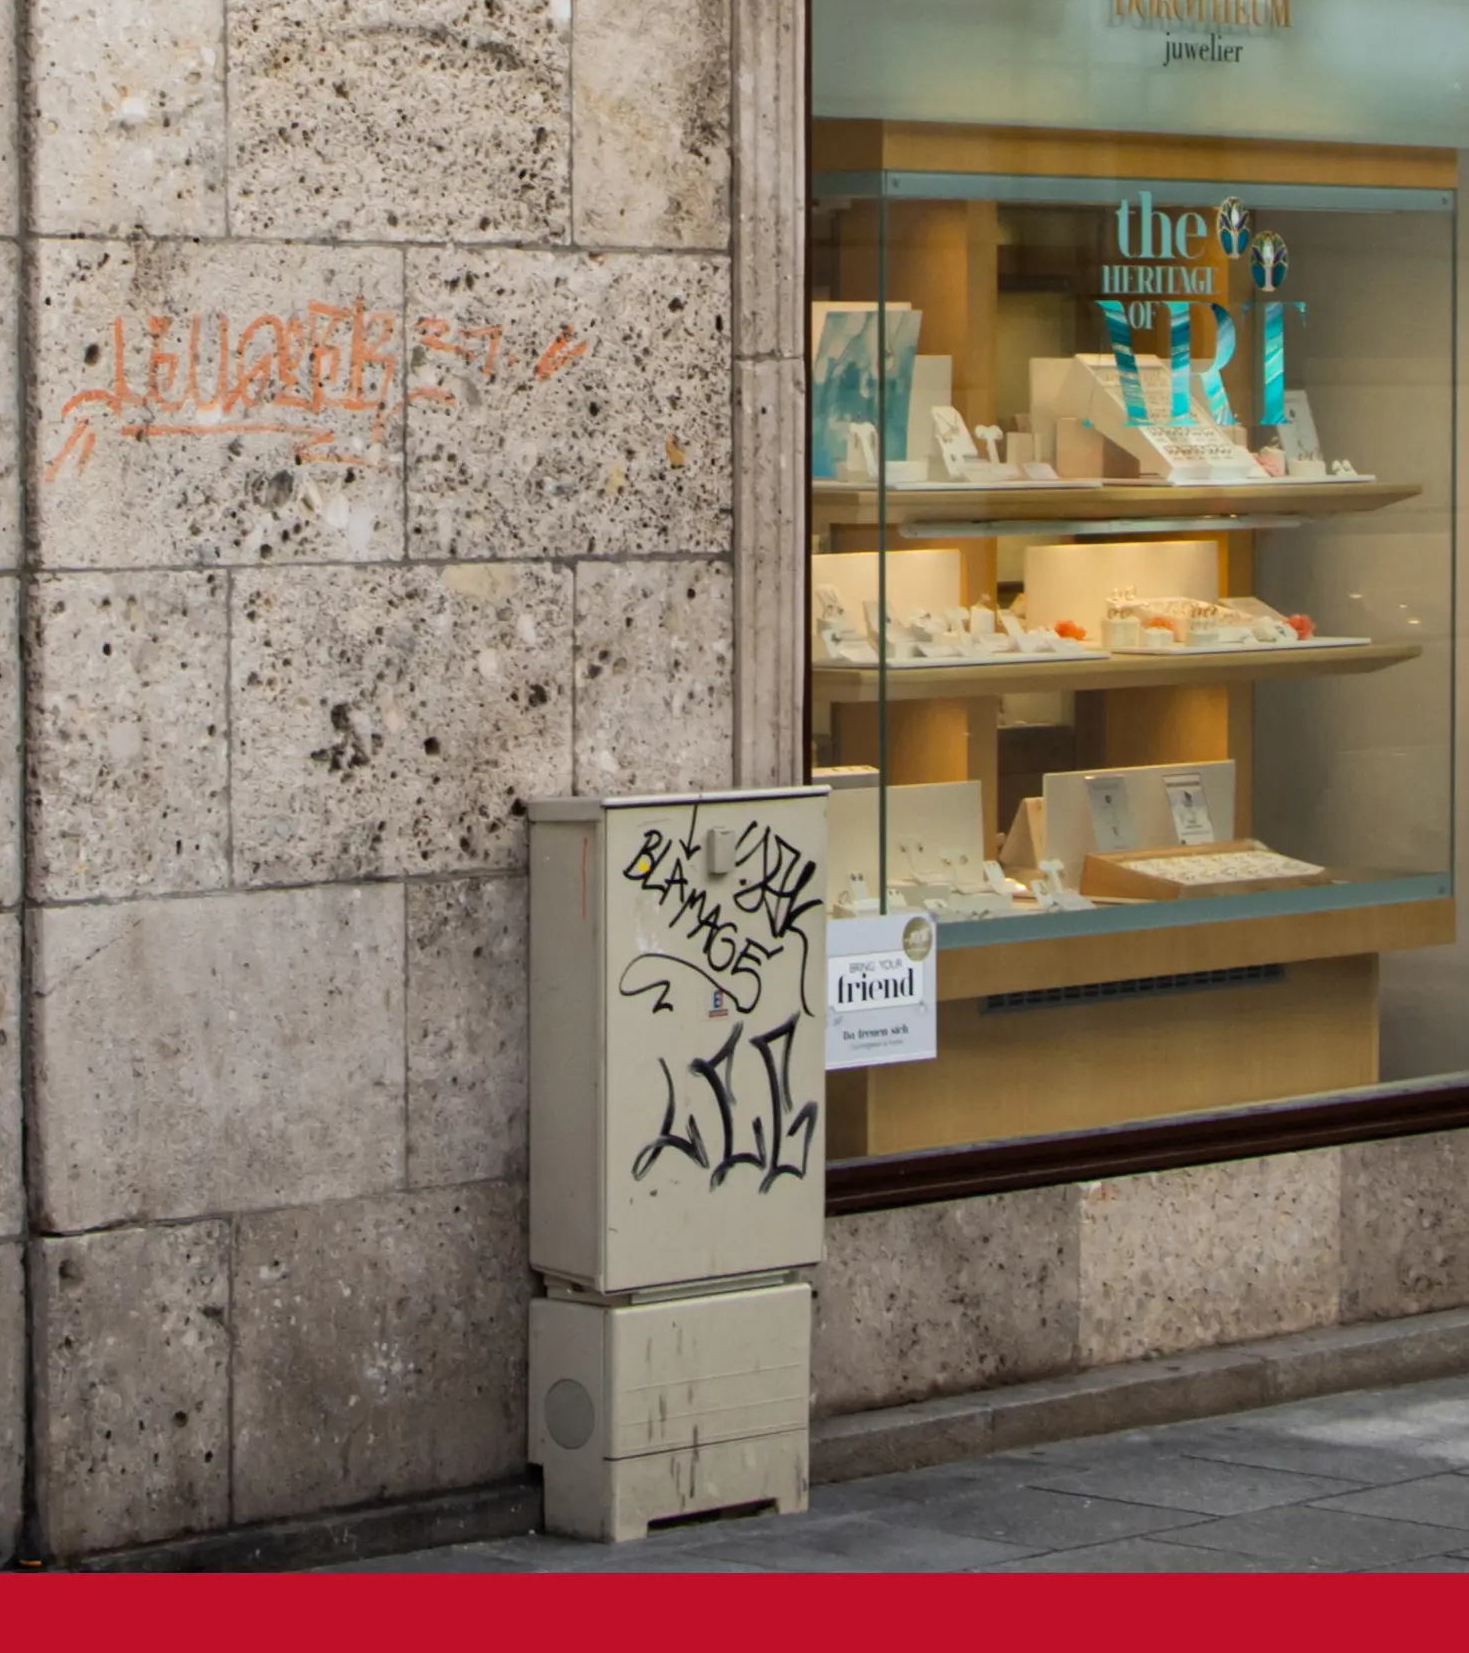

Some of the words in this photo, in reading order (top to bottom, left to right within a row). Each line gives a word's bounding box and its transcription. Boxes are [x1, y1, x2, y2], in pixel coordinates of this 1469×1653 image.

[1163, 32, 1244, 67] juwelier
[1115, 191, 1208, 260] the
[1101, 264, 1222, 295] HERITAGE
[1128, 300, 1160, 330] OF
[837, 967, 915, 1005] friend
